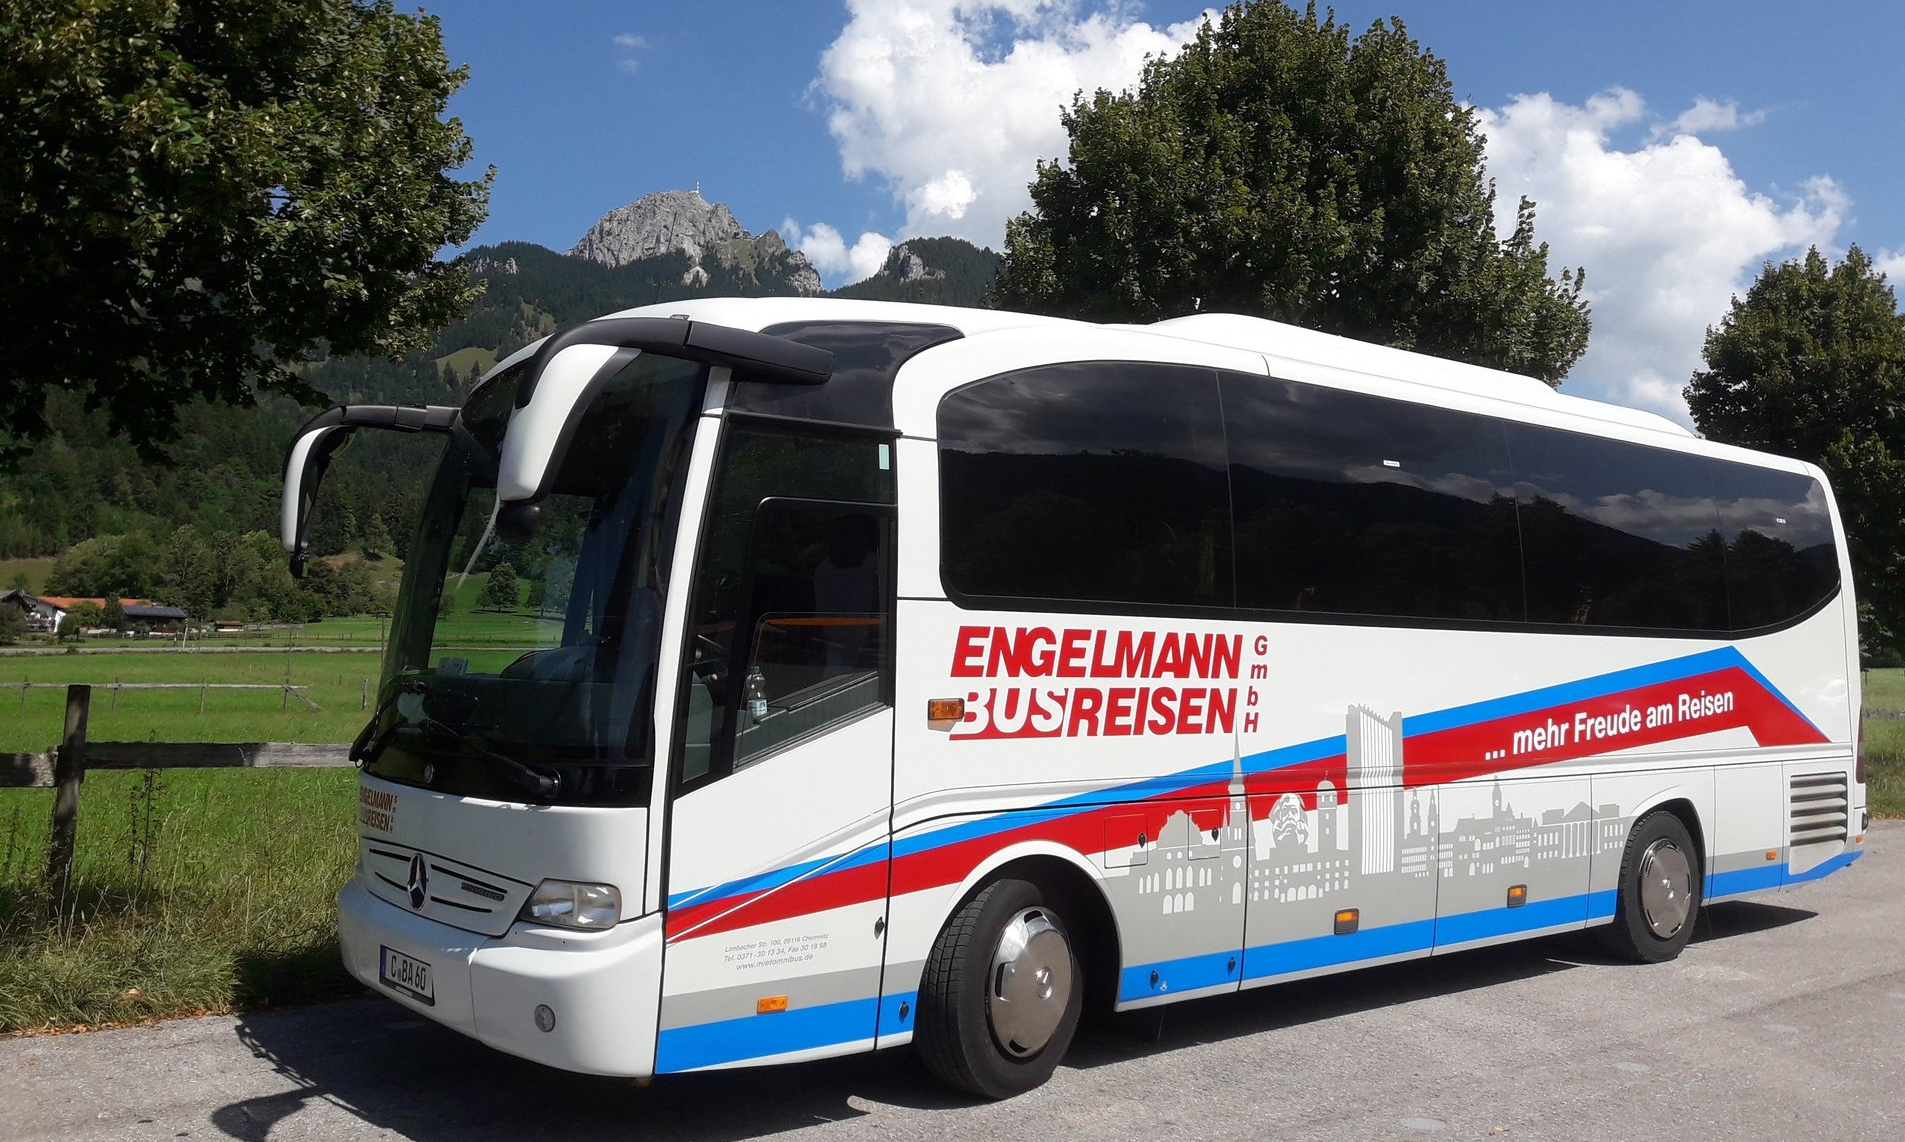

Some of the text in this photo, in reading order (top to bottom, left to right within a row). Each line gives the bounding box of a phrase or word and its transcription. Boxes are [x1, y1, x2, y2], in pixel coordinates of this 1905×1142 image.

[950, 626, 1243, 679] ENGELMANN
[949, 687, 1238, 740] BUSREISEN
[1512, 718, 1570, 755] mehr
[1574, 705, 1642, 743] Freude
[1646, 703, 1673, 728] am
[1677, 690, 1734, 722] Reisen
[359, 806, 391, 833] REISEN
[725, 943, 757, 953] Limbacher
[758, 941, 768, 949] Str.
[801, 933, 829, 942] Chemnitz
[787, 946, 799, 954] Fax
[391, 955, 397, 978] C
[401, 959, 413, 986] BA
[414, 965, 427, 991] 60
[736, 953, 814, 970] www.mietomnibus.de
